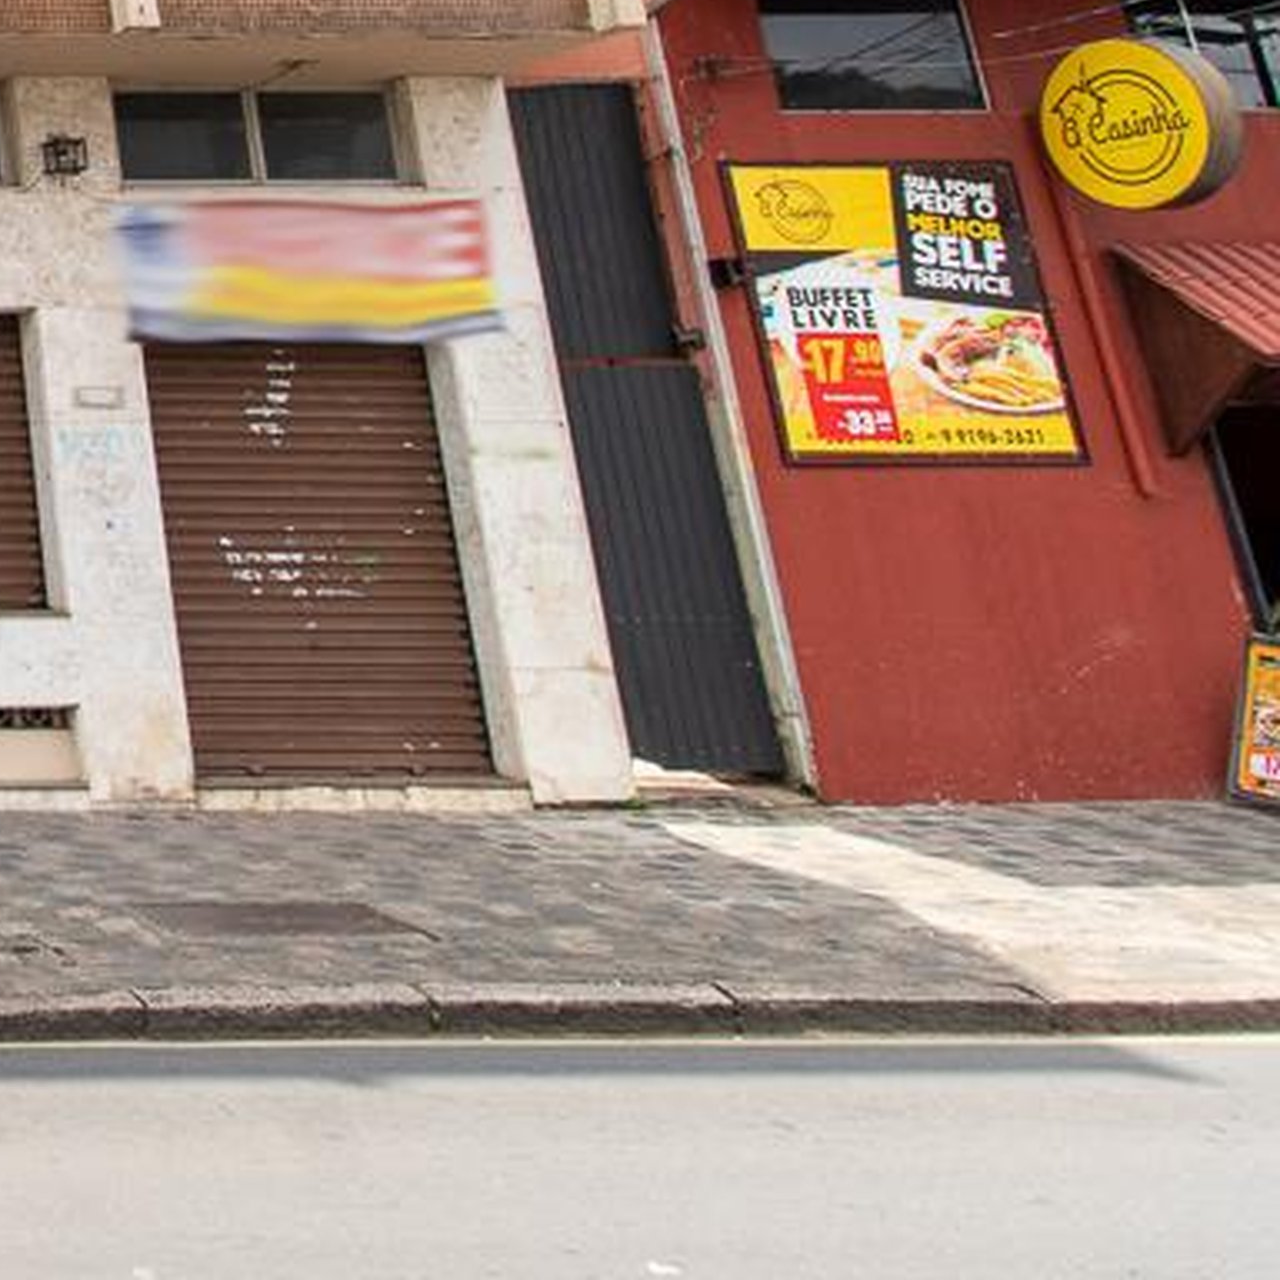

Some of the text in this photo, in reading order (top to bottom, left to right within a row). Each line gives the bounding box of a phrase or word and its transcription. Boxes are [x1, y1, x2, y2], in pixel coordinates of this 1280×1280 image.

[906, 191, 999, 220] PEDE O
[906, 212, 1002, 240] MELHOR
[912, 231, 1006, 274] SELF
[914, 266, 1014, 297] SERVICE
[787, 287, 873, 308] BUFFET
[791, 309, 877, 329] LIVRE
